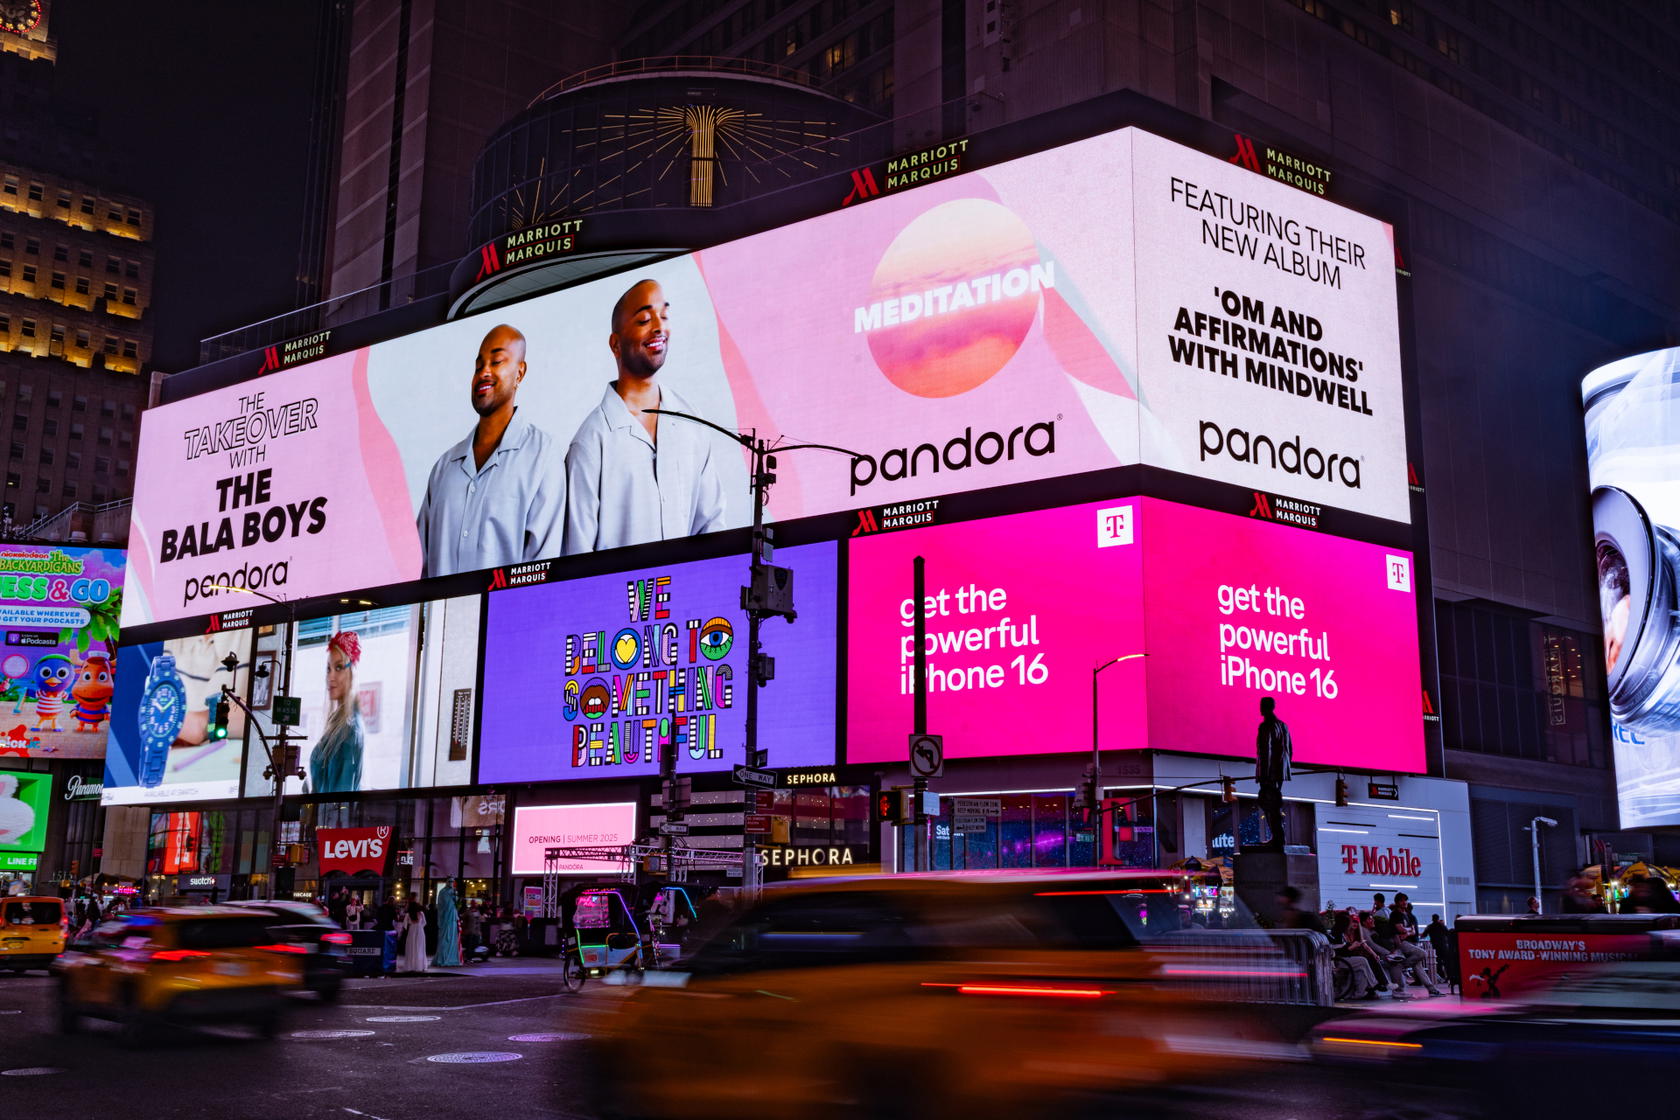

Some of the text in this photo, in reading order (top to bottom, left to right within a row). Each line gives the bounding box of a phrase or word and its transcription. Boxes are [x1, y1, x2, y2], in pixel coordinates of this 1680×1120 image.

[887, 139, 969, 173] MARRIOTT
[1266, 147, 1332, 182] MARRIOTT
[887, 158, 960, 189] MARQUIS
[1267, 164, 1325, 195] MARQUIS
[507, 219, 584, 248] MARRIOTT
[1170, 176, 1366, 270] FEATURING THEIR
[505, 237, 573, 265] MARQUIS
[1202, 218, 1342, 290] NEW ALBUM
[854, 260, 1055, 334] MEDITATION
[1213, 286, 1324, 342] 'OM AND
[283, 345, 325, 365] MARQUIS
[284, 330, 331, 354] MARRIOTT
[1173, 306, 1364, 383] AFFIRMATIONS'
[1168, 334, 1374, 416] WITH MINDWELL
[238, 391, 265, 415] THE
[183, 397, 319, 461] TAKEOVER
[228, 446, 266, 469] WITH
[850, 421, 1056, 497] pandora
[1199, 419, 1362, 489] pandora
[215, 467, 273, 512] THE
[883, 499, 940, 518] MARRIOTT
[883, 512, 933, 529] MARQUIS
[1275, 498, 1321, 517] MARRIOTT
[1275, 509, 1317, 528] MARQUIS
[160, 496, 329, 564] BALA BOYS
[182, 560, 289, 607] pandora
[510, 562, 552, 575] MARRIOTT
[510, 572, 547, 586] MARQUIS
[0, 576, 110, 603] ESS & GO
[626, 575, 672, 624] WE
[1217, 584, 1305, 620] get the
[37, 610, 81, 618] WHEREVER
[43, 617, 85, 625] PODCASTS
[222, 608, 254, 622] MARRIOTT
[899, 584, 1008, 628] get the
[222, 617, 250, 630] MARQUIS
[564, 615, 735, 678] BELONG TO
[900, 614, 1040, 665] powerful
[1219, 623, 1331, 662] powerful
[1011, 652, 1049, 685] 16
[1220, 654, 1339, 700] iPhone 16
[562, 663, 734, 722] SOMETHING
[740, 770, 771, 783] ONE WAY
[787, 772, 836, 785] SEPHORA
[528, 833, 618, 844] OPENING SUMMER 2025
[936, 825, 950, 836] Sat
[7, 857, 27, 866] LINE
[761, 847, 854, 867] SEPHORA
[1361, 845, 1421, 877] Mobile
[190, 876, 212, 886] swatch
[1468, 949, 1495, 960] TONY
[1516, 939, 1586, 951] BROADWAY'S
